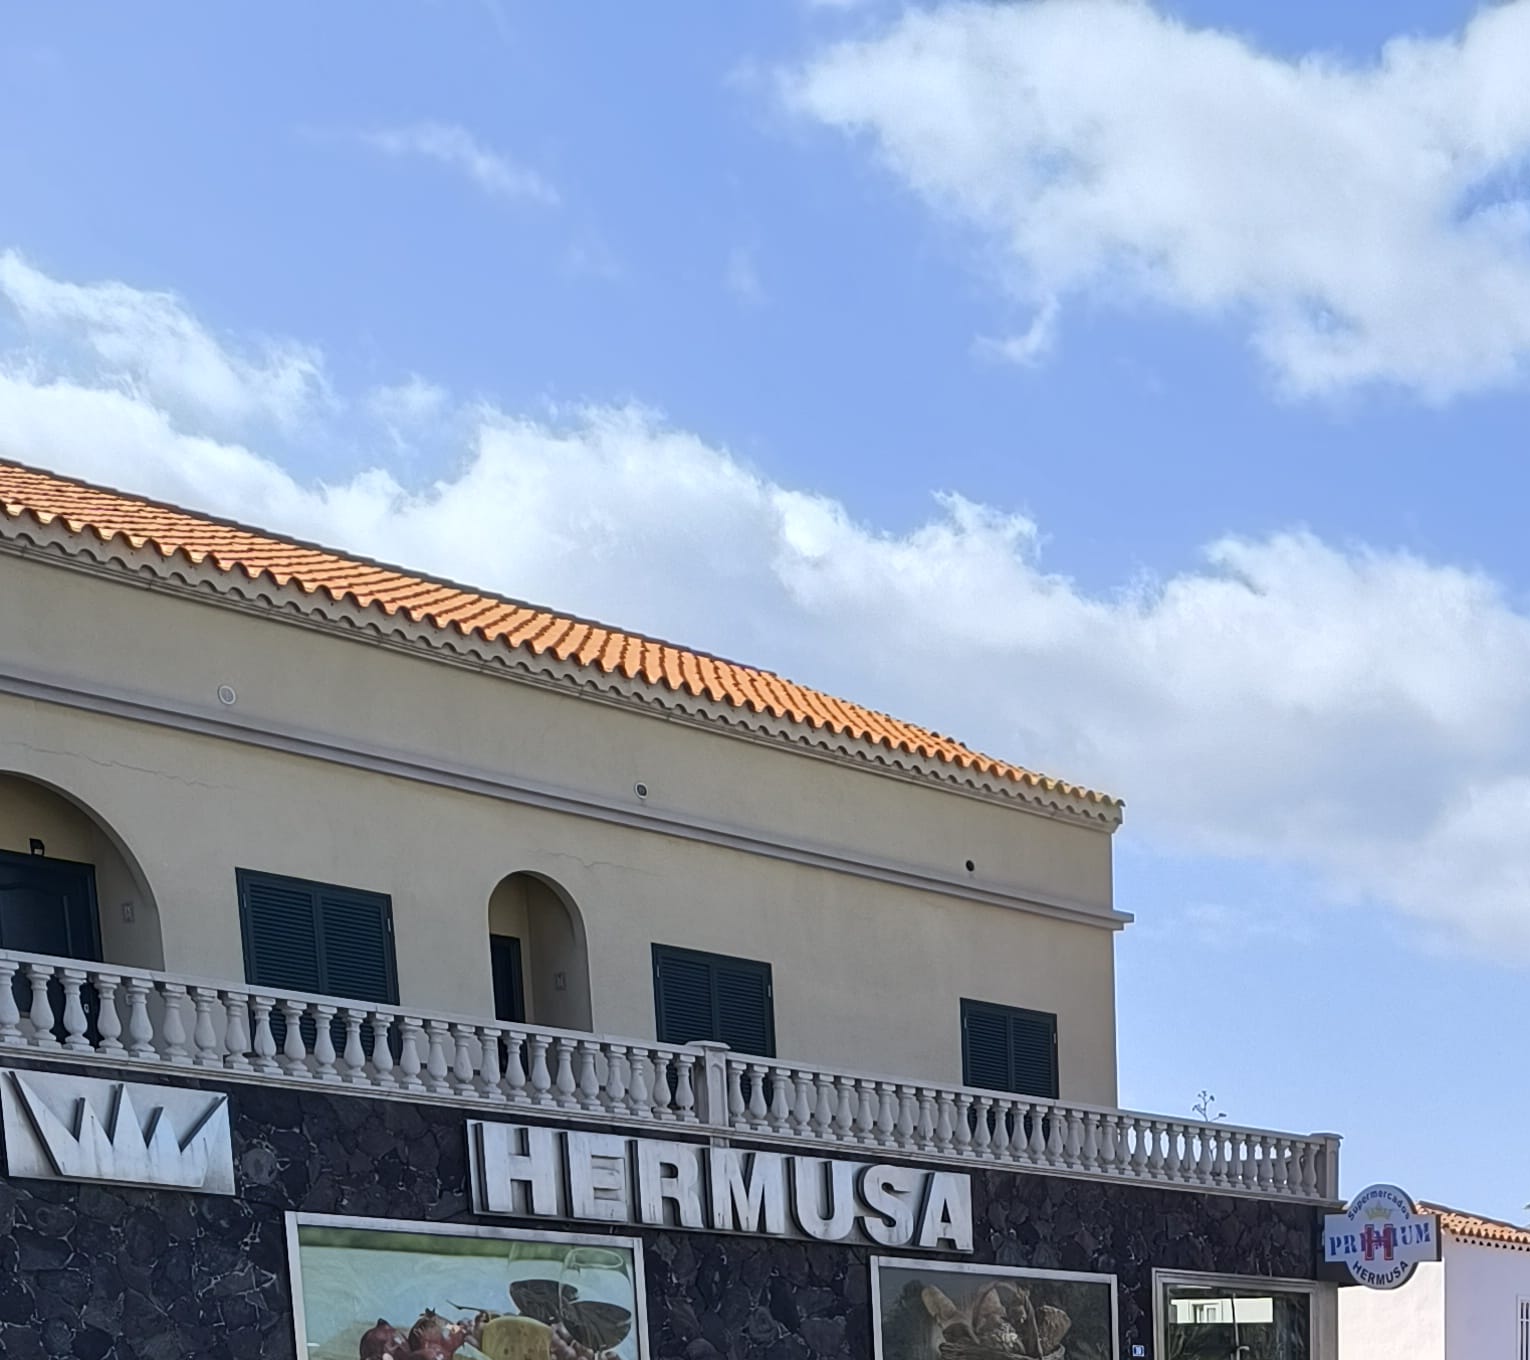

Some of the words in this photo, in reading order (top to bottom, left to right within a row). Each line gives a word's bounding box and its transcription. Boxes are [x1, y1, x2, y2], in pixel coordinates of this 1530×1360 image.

[480, 1122, 974, 1250] HERMUSA
[1347, 1190, 1411, 1221] Supermercados
[1329, 1222, 1431, 1256] PRIUM
[1364, 1223, 1394, 1261] H
[1352, 1260, 1409, 1286] HERMUSA
